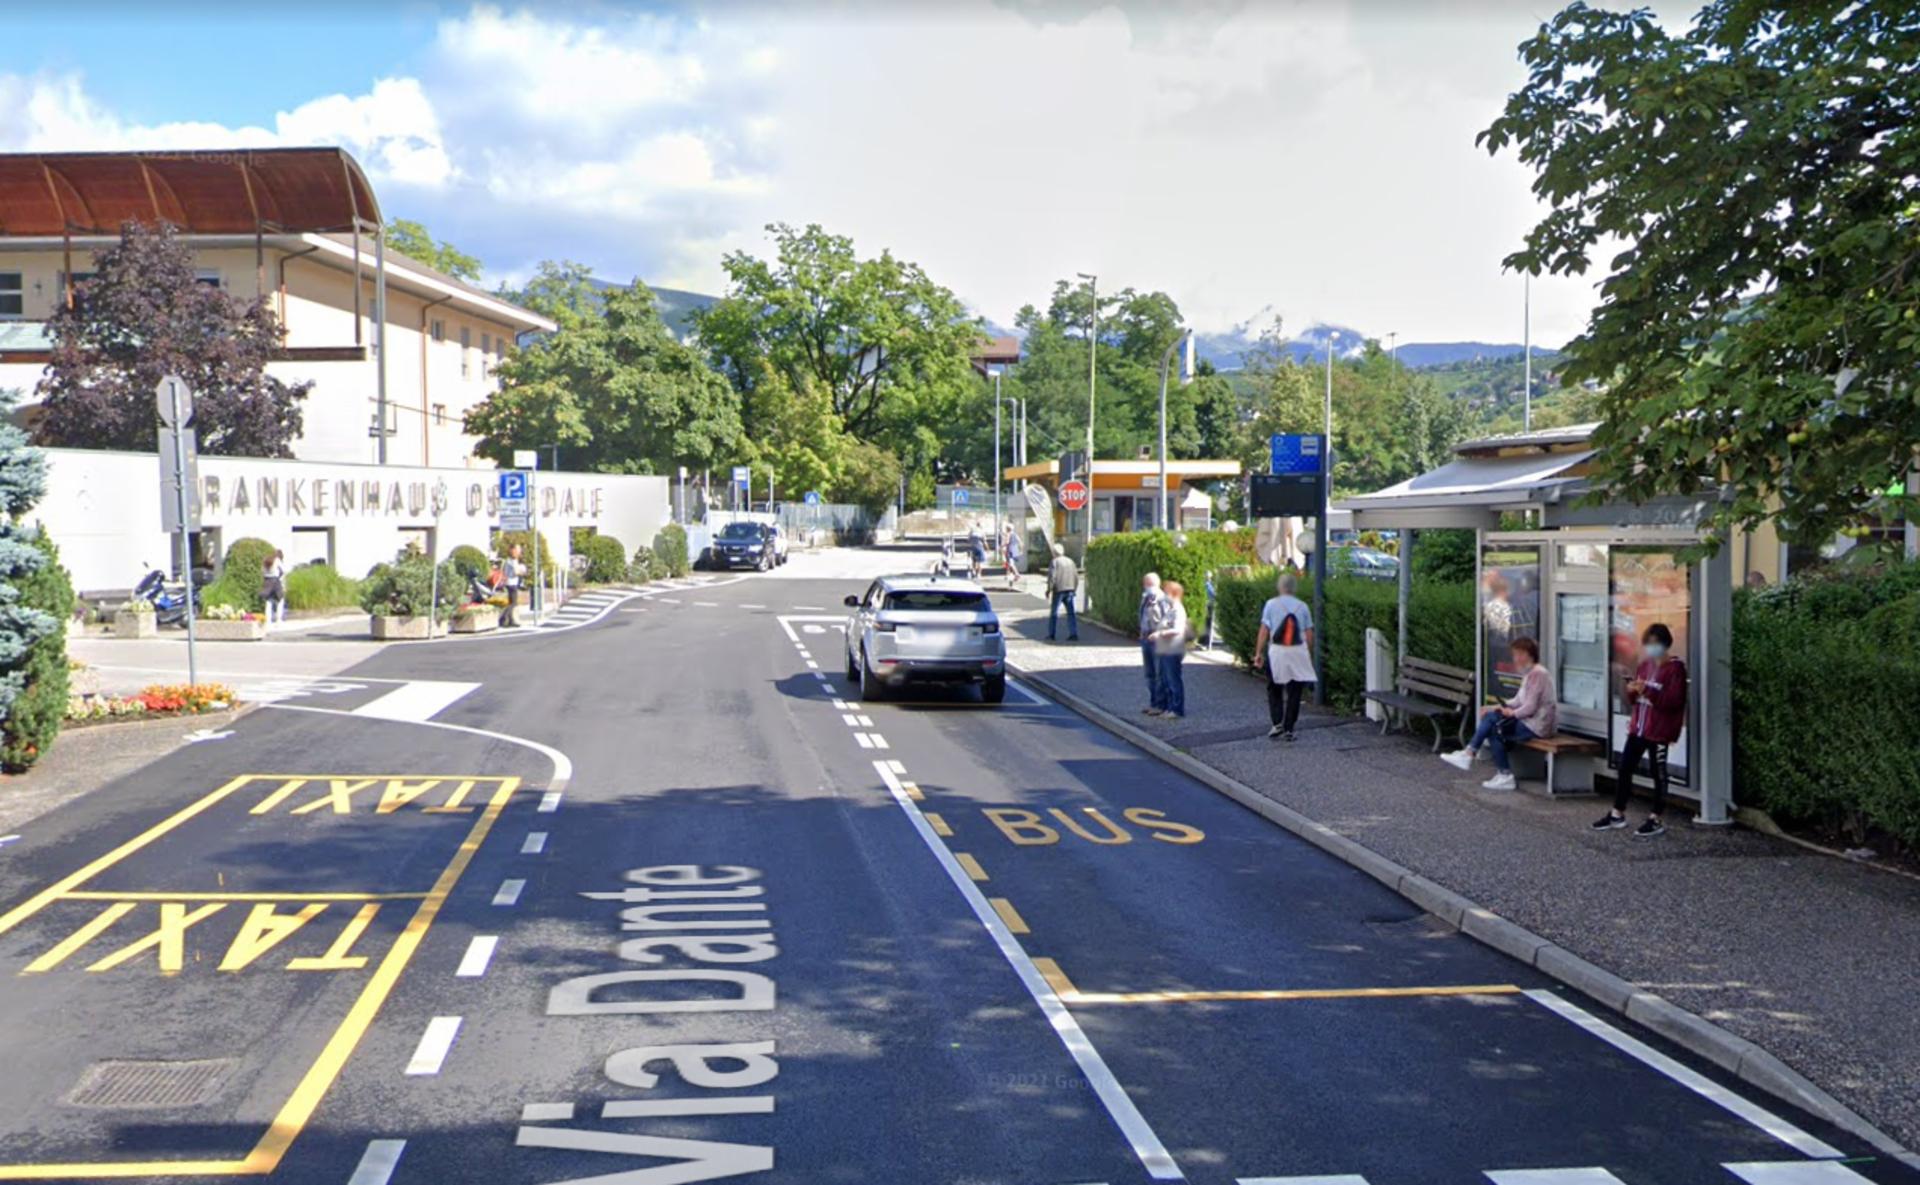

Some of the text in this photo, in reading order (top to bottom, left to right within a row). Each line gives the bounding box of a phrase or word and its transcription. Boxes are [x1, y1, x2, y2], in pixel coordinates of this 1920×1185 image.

[199, 475, 448, 518] RANKENHAUS
[505, 476, 521, 498] P
[1060, 489, 1086, 501] STOP
[248, 779, 476, 814] TAXI
[981, 807, 1206, 845] BUS
[18, 902, 382, 977] TAXI
[515, 864, 782, 1185] Via Dante
